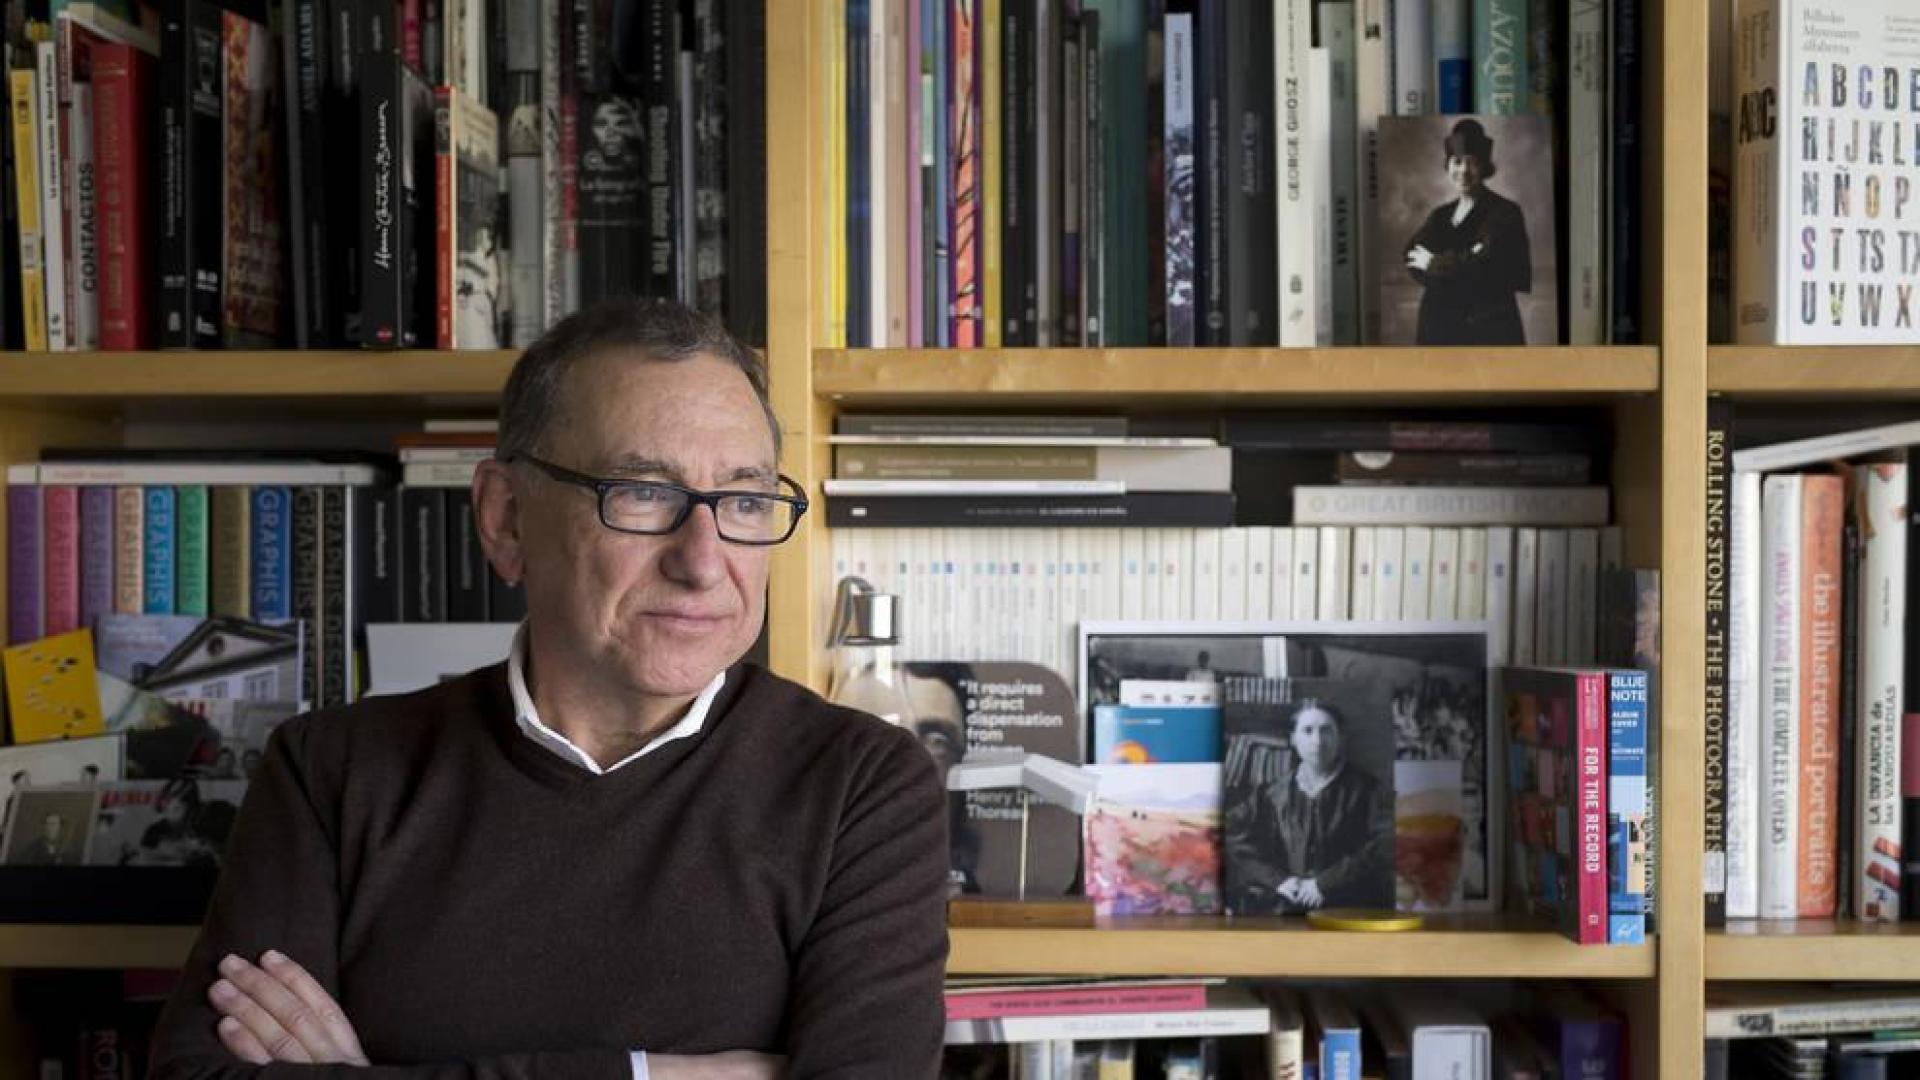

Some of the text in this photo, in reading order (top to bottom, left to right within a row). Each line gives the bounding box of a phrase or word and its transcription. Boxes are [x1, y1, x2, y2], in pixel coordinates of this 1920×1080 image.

[1285, 77, 1299, 132] GROSZ
[1804, 62, 1819, 106] A
[1832, 64, 1847, 108] B
[1859, 65, 1873, 109] C
[1884, 67, 1899, 110] D
[1286, 136, 1300, 201] GEORGE
[1803, 116, 1906, 166] H I J K L
[649, 105, 670, 274] Shooting Under Fire
[1803, 165, 1909, 219] N Ñ O P
[79, 162, 97, 292] CONTACTOS
[1802, 227, 1816, 272] S
[1831, 228, 1844, 272] T
[1857, 229, 1885, 273] TS
[1801, 281, 1912, 328] U V W X
[119, 489, 141, 605] GRAPHIS
[148, 490, 170, 605] GRAPHIS
[257, 489, 280, 605] GRAPHIS
[323, 490, 343, 610] GRAPHIS
[1813, 573, 1838, 615] the
[1705, 430, 1725, 853] ROLLING STONE THE PHOTOGRAPHS
[966, 697, 1025, 711] a direct
[980, 679, 1044, 697] requires
[1611, 676, 1646, 688] BLUE
[1611, 690, 1646, 702] NOTE
[1773, 677, 1790, 704] THE
[1812, 619, 1836, 761] illustrated
[966, 711, 1064, 729] dispensation
[966, 728, 1004, 742] from
[1772, 709, 1790, 784] COMPLETE
[1884, 685, 1897, 799] VANGUARDIAS
[1868, 702, 1883, 825] LA INFANCIA de
[1585, 747, 1600, 873] FOR THE RECORD
[1805, 765, 1833, 886] portraits
